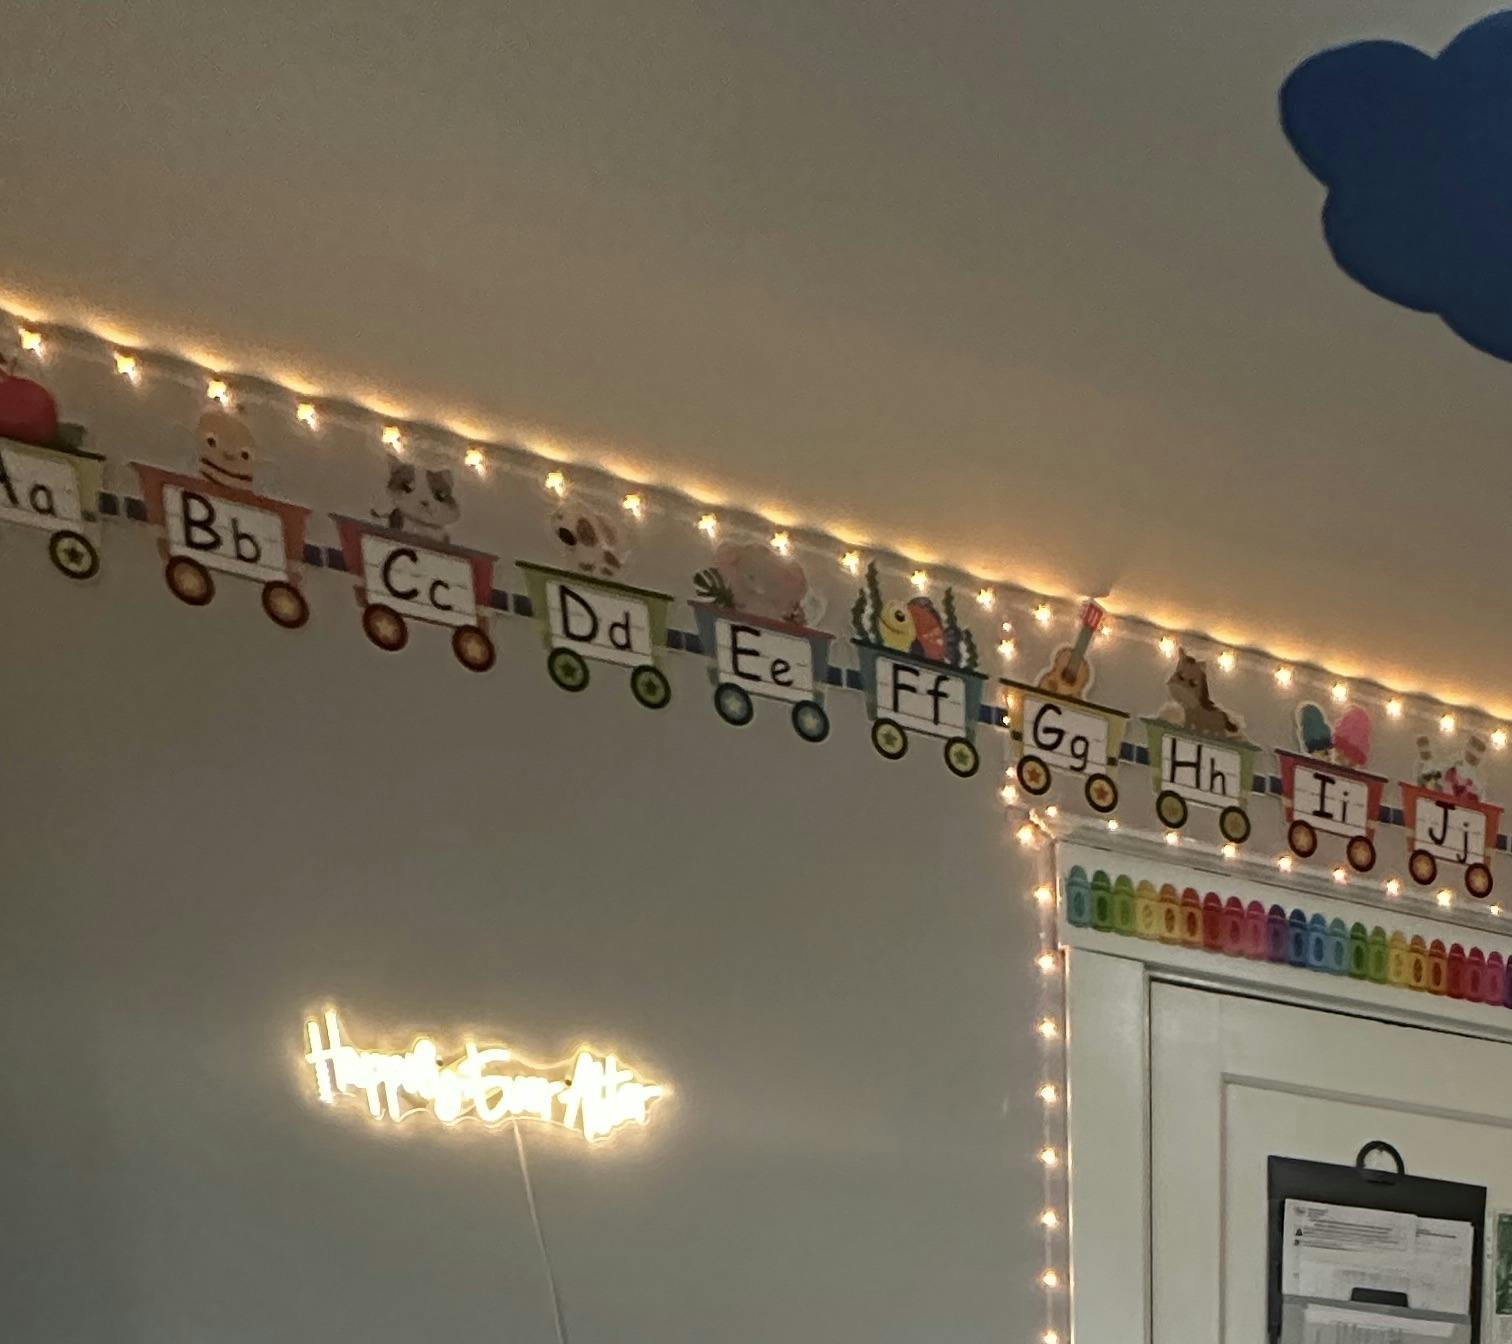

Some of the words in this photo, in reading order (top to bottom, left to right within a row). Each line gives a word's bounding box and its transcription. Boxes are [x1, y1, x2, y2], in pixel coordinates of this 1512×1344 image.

[180, 491, 262, 565] Bb
[380, 547, 455, 613] Cc
[559, 585, 635, 652] Dd
[730, 624, 795, 688] Ee
[892, 662, 949, 725] Ff
[1032, 703, 1090, 772] Gg
[1168, 738, 1228, 795] Hh
[1312, 771, 1350, 823] Ii
[1428, 801, 1472, 865] Jj
